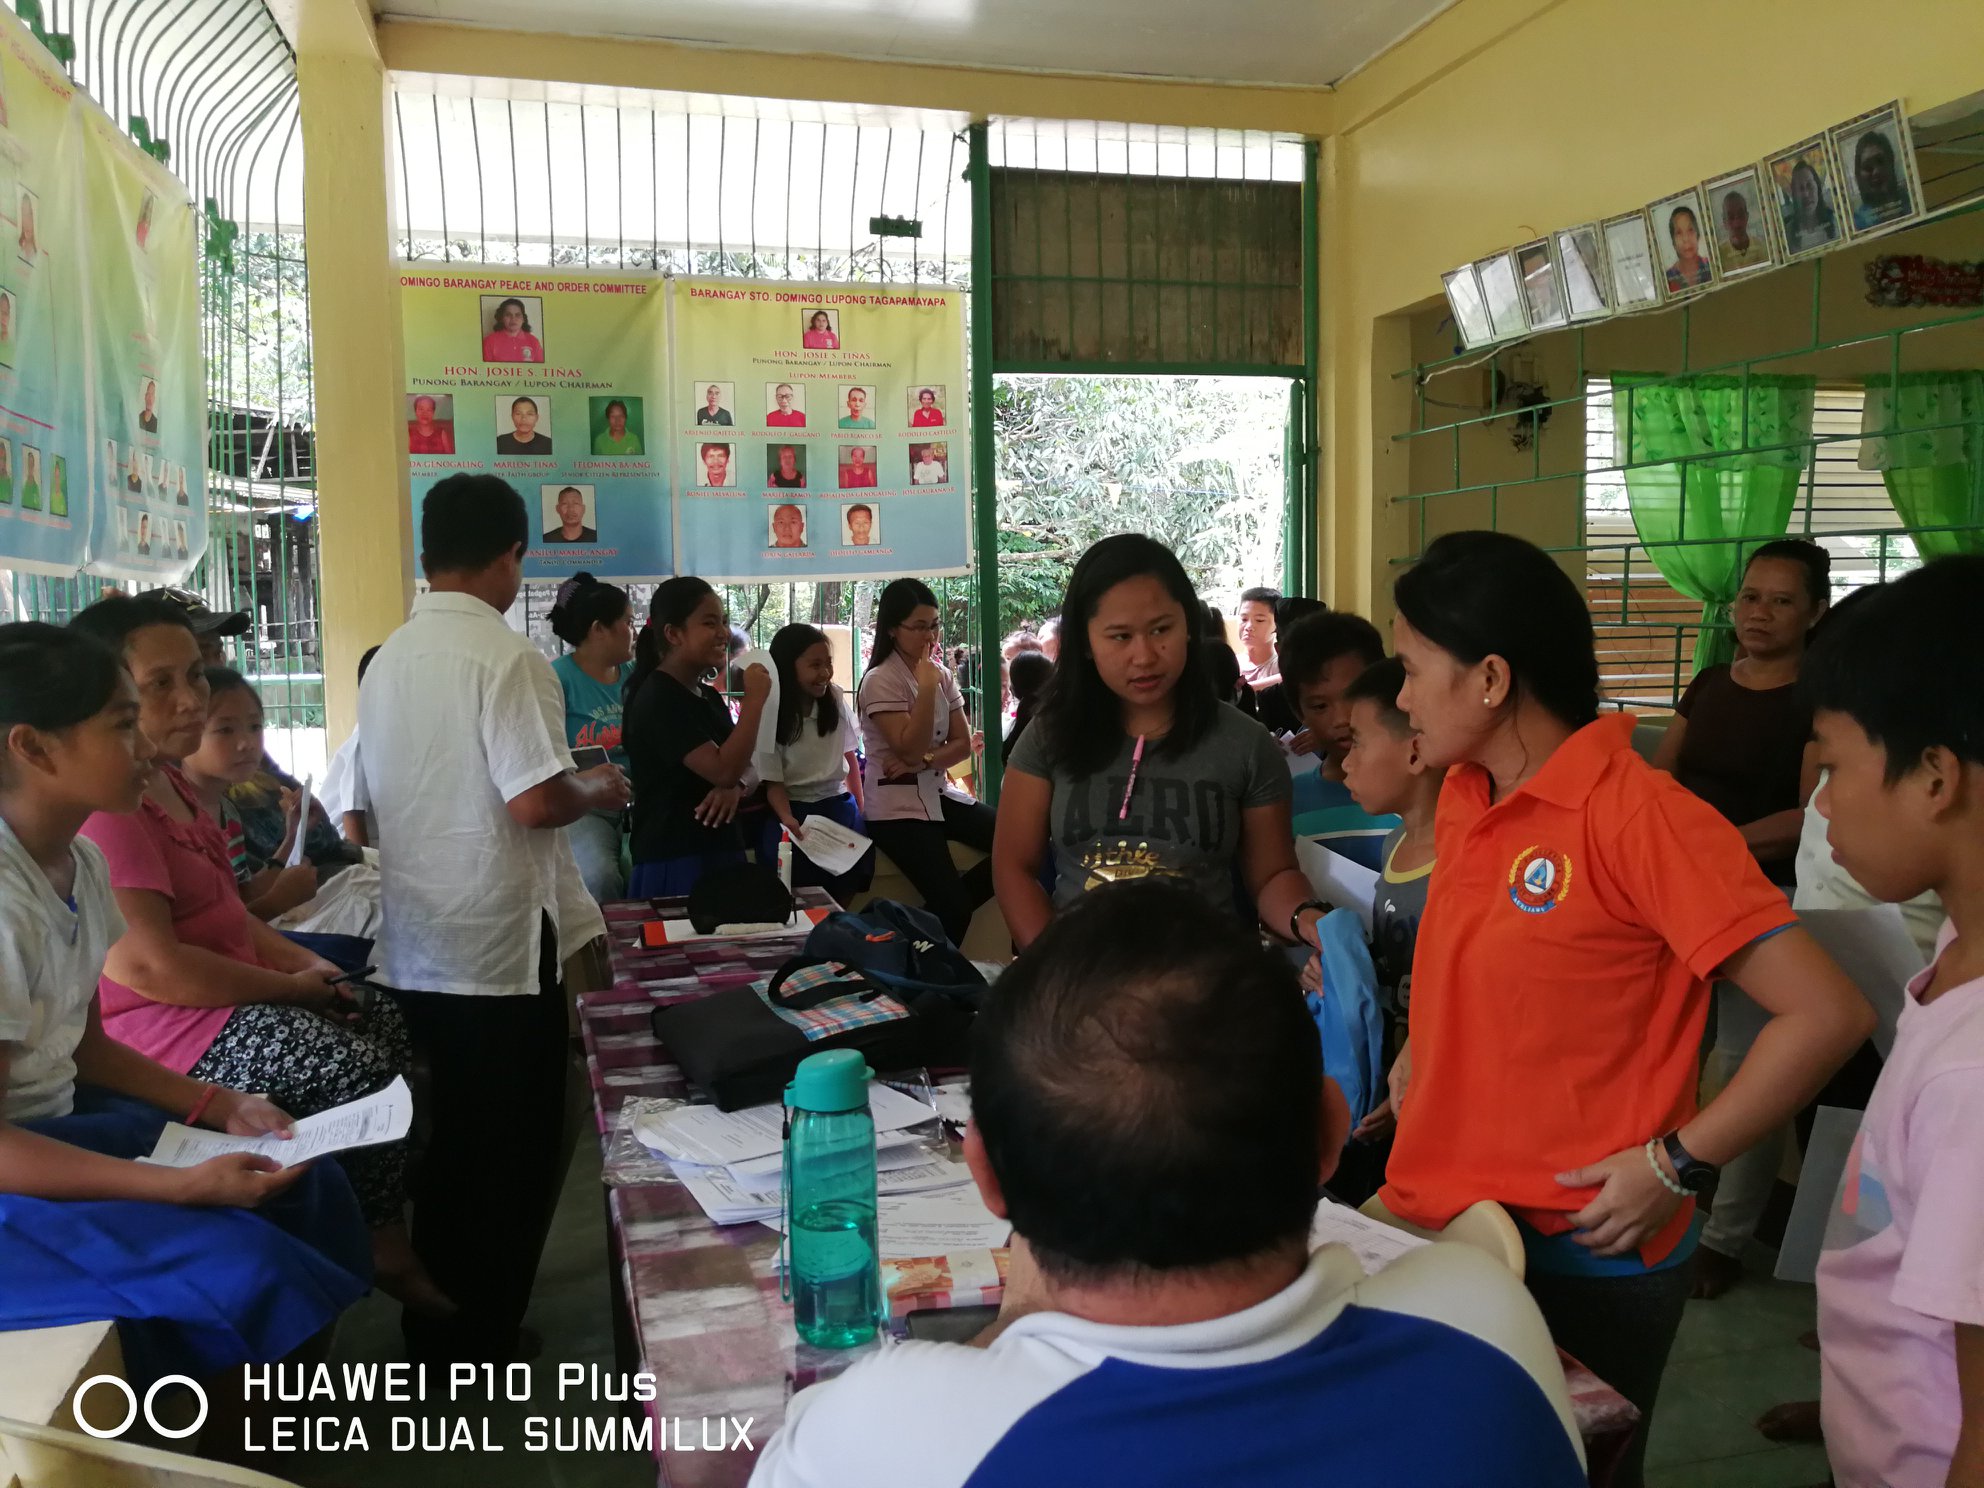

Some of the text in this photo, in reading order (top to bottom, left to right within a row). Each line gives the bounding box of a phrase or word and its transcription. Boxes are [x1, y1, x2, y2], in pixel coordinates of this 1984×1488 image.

[400, 276, 647, 295] OMINGO BARANGAY PEACE AND ORDER COMMITTEE
[690, 287, 946, 307] BARANGAY STO. DOMINGO LUPONG TAGAPAMAYAPA
[486, 366, 523, 378] JOSIE
[412, 377, 457, 387] PUNONG
[460, 378, 512, 388] BARANGAY
[523, 379, 556, 389] LUPON
[559, 380, 613, 390] CHAIRMAN
